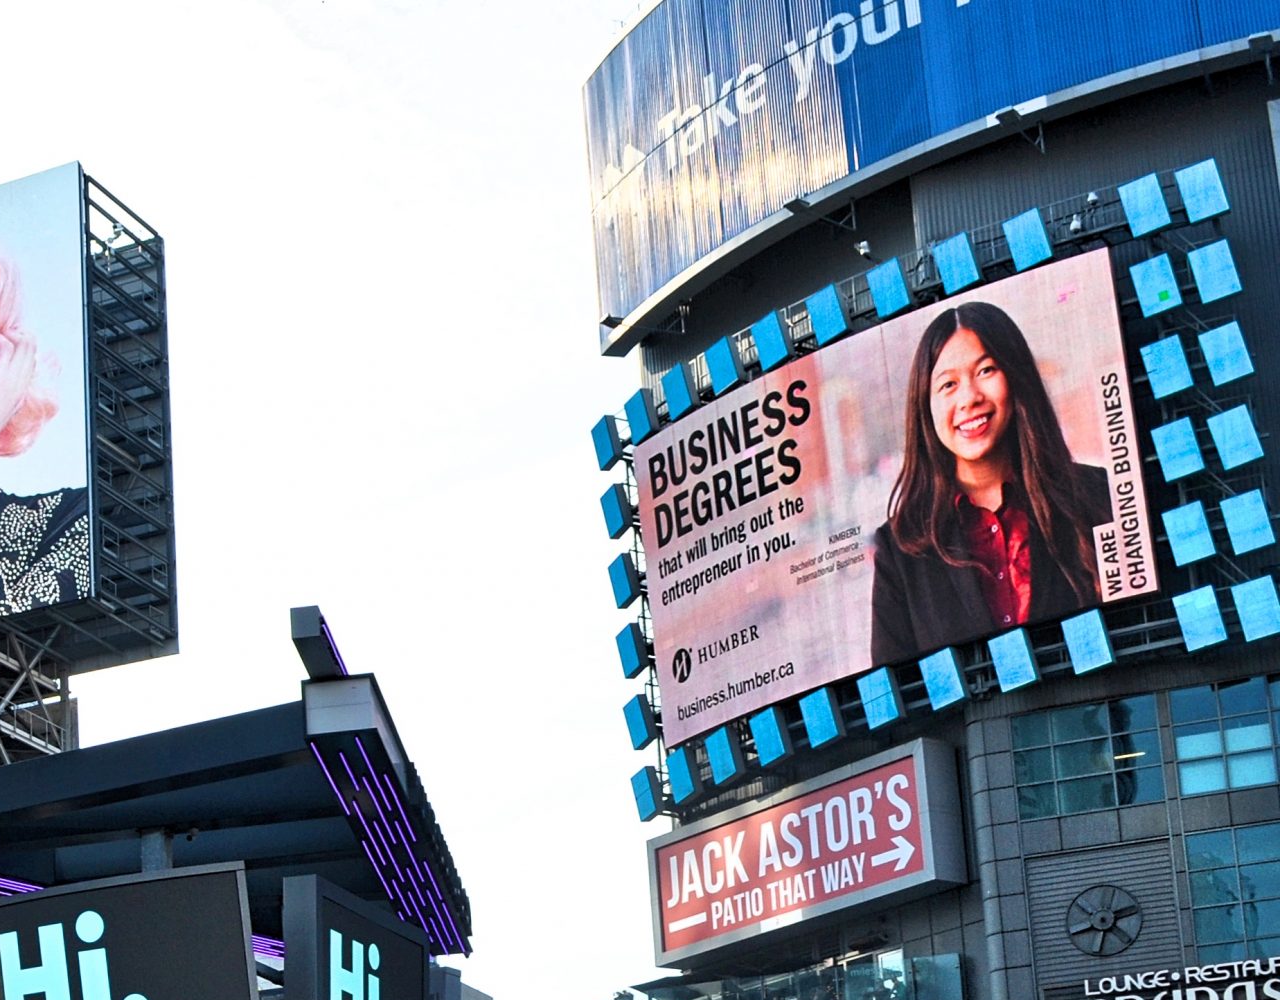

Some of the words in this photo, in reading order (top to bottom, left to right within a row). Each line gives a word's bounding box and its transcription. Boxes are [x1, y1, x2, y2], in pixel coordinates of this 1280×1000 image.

[656, 60, 767, 171] Take
[648, 379, 811, 500] BUSINESS
[1101, 372, 1131, 475] BUSINESS
[654, 438, 802, 549] DEGREES
[658, 555, 684, 580] that
[685, 536, 708, 567] will
[711, 520, 746, 552] bring
[750, 506, 774, 533] out
[779, 496, 804, 521] the
[661, 552, 743, 606] entrepreneur
[746, 544, 761, 565] in
[763, 532, 796, 562] you.
[824, 541, 859, 560] Commerce
[828, 525, 862, 545] KIMBERLY
[1100, 529, 1121, 565] ARE
[1116, 480, 1147, 590] CHANGING
[1106, 567, 1123, 596] WE
[697, 624, 760, 665] HUMBER
[677, 661, 795, 721] business.humber.ca
[667, 829, 750, 909] JACK
[758, 773, 913, 878] ASTOR'S
[710, 887, 764, 930] PATIO
[766, 869, 817, 912] THAT
[820, 852, 866, 894] WAY
[1084, 969, 1170, 996] LOUNGE
